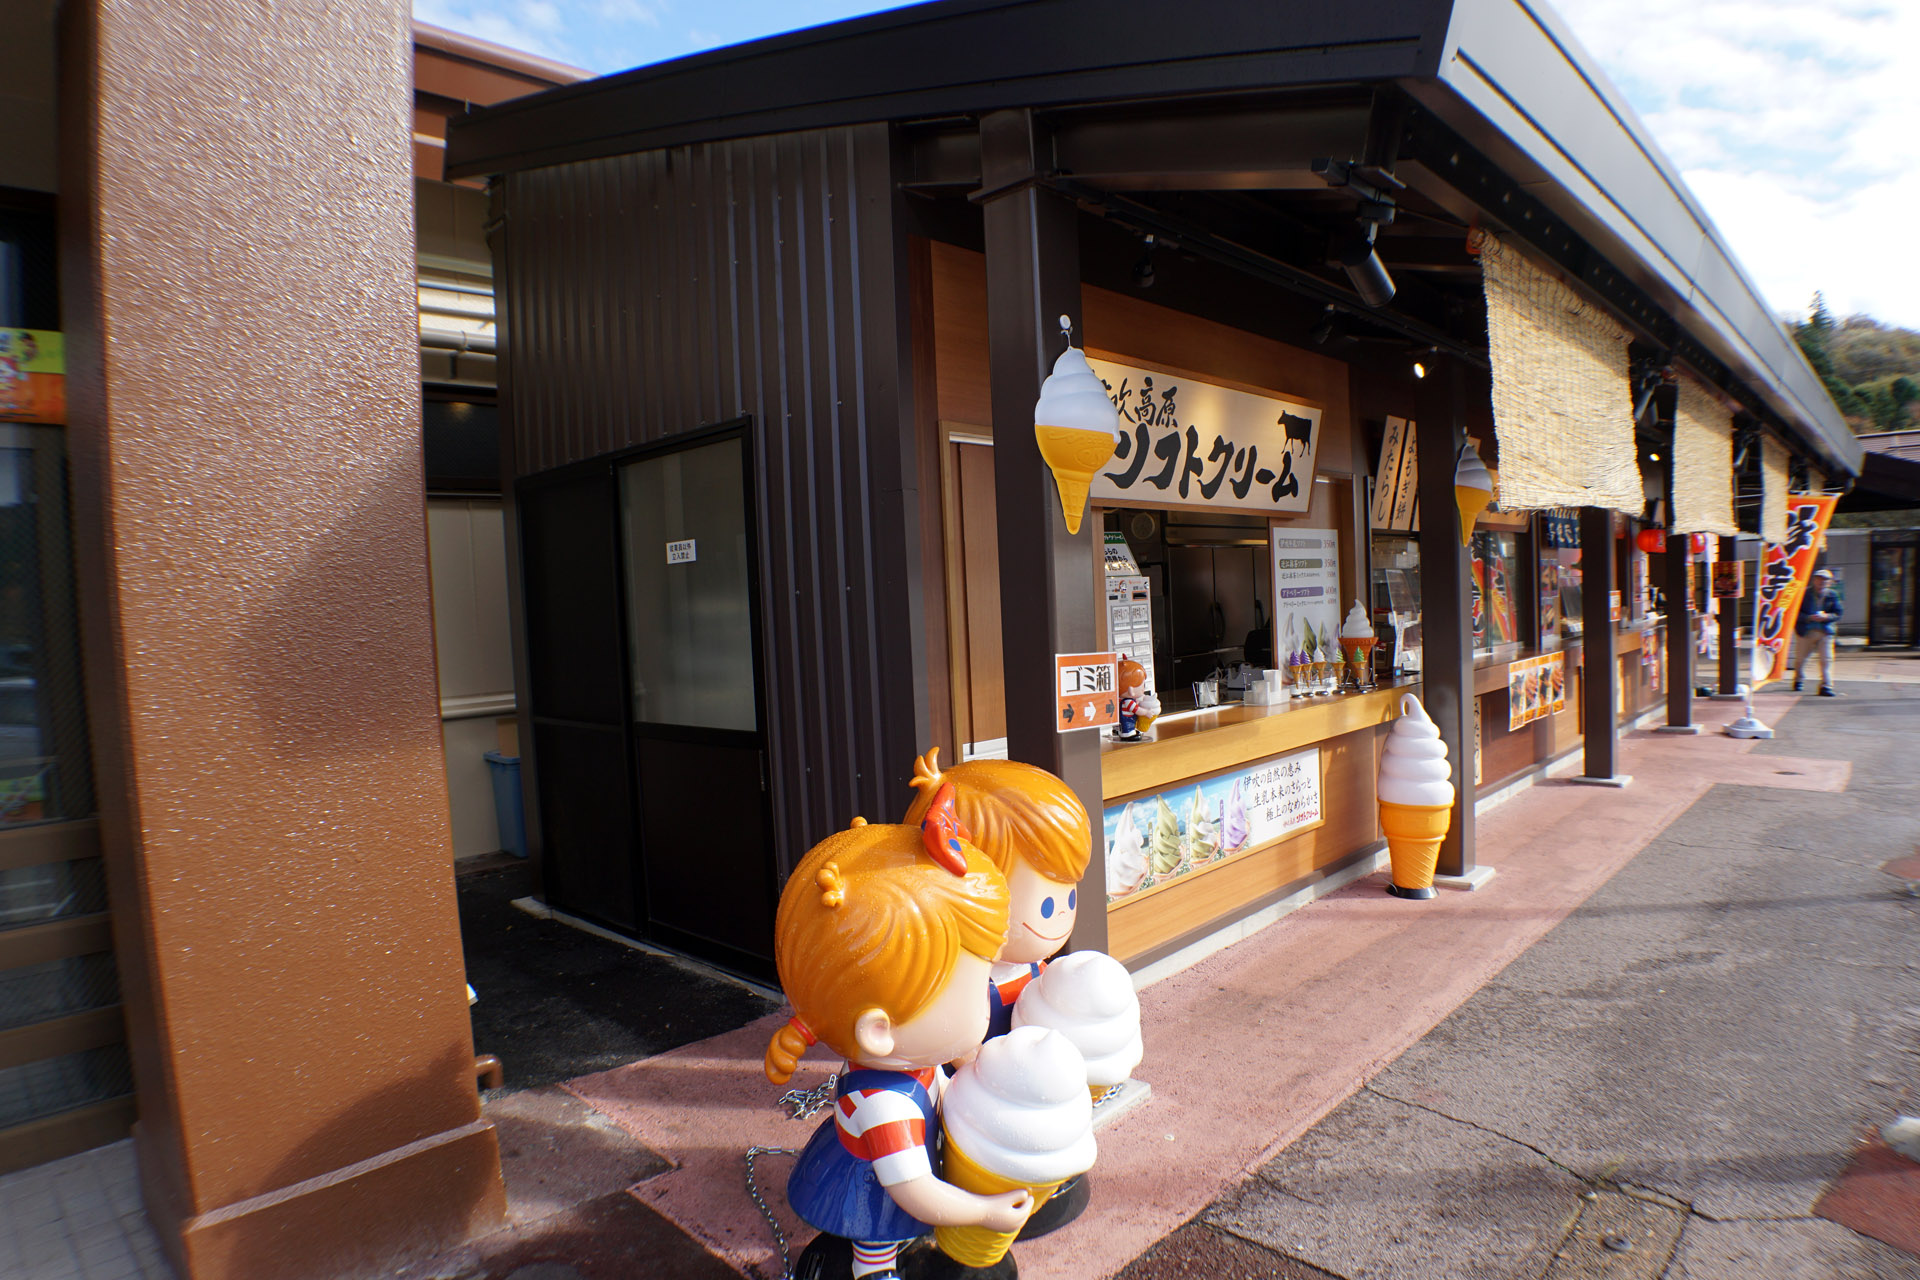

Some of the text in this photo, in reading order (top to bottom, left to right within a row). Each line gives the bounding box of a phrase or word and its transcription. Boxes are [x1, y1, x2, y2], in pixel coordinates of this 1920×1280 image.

[1102, 422, 1299, 503] ソフトクリーム
[1378, 425, 1399, 522] みたらし
[1065, 665, 1111, 693] ゴミ箱
[1243, 761, 1302, 792] 伊吹の自然の恵み
[1253, 777, 1312, 808] 生乳本来のさらっと
[1266, 791, 1318, 822] 極上のなめらかさ
